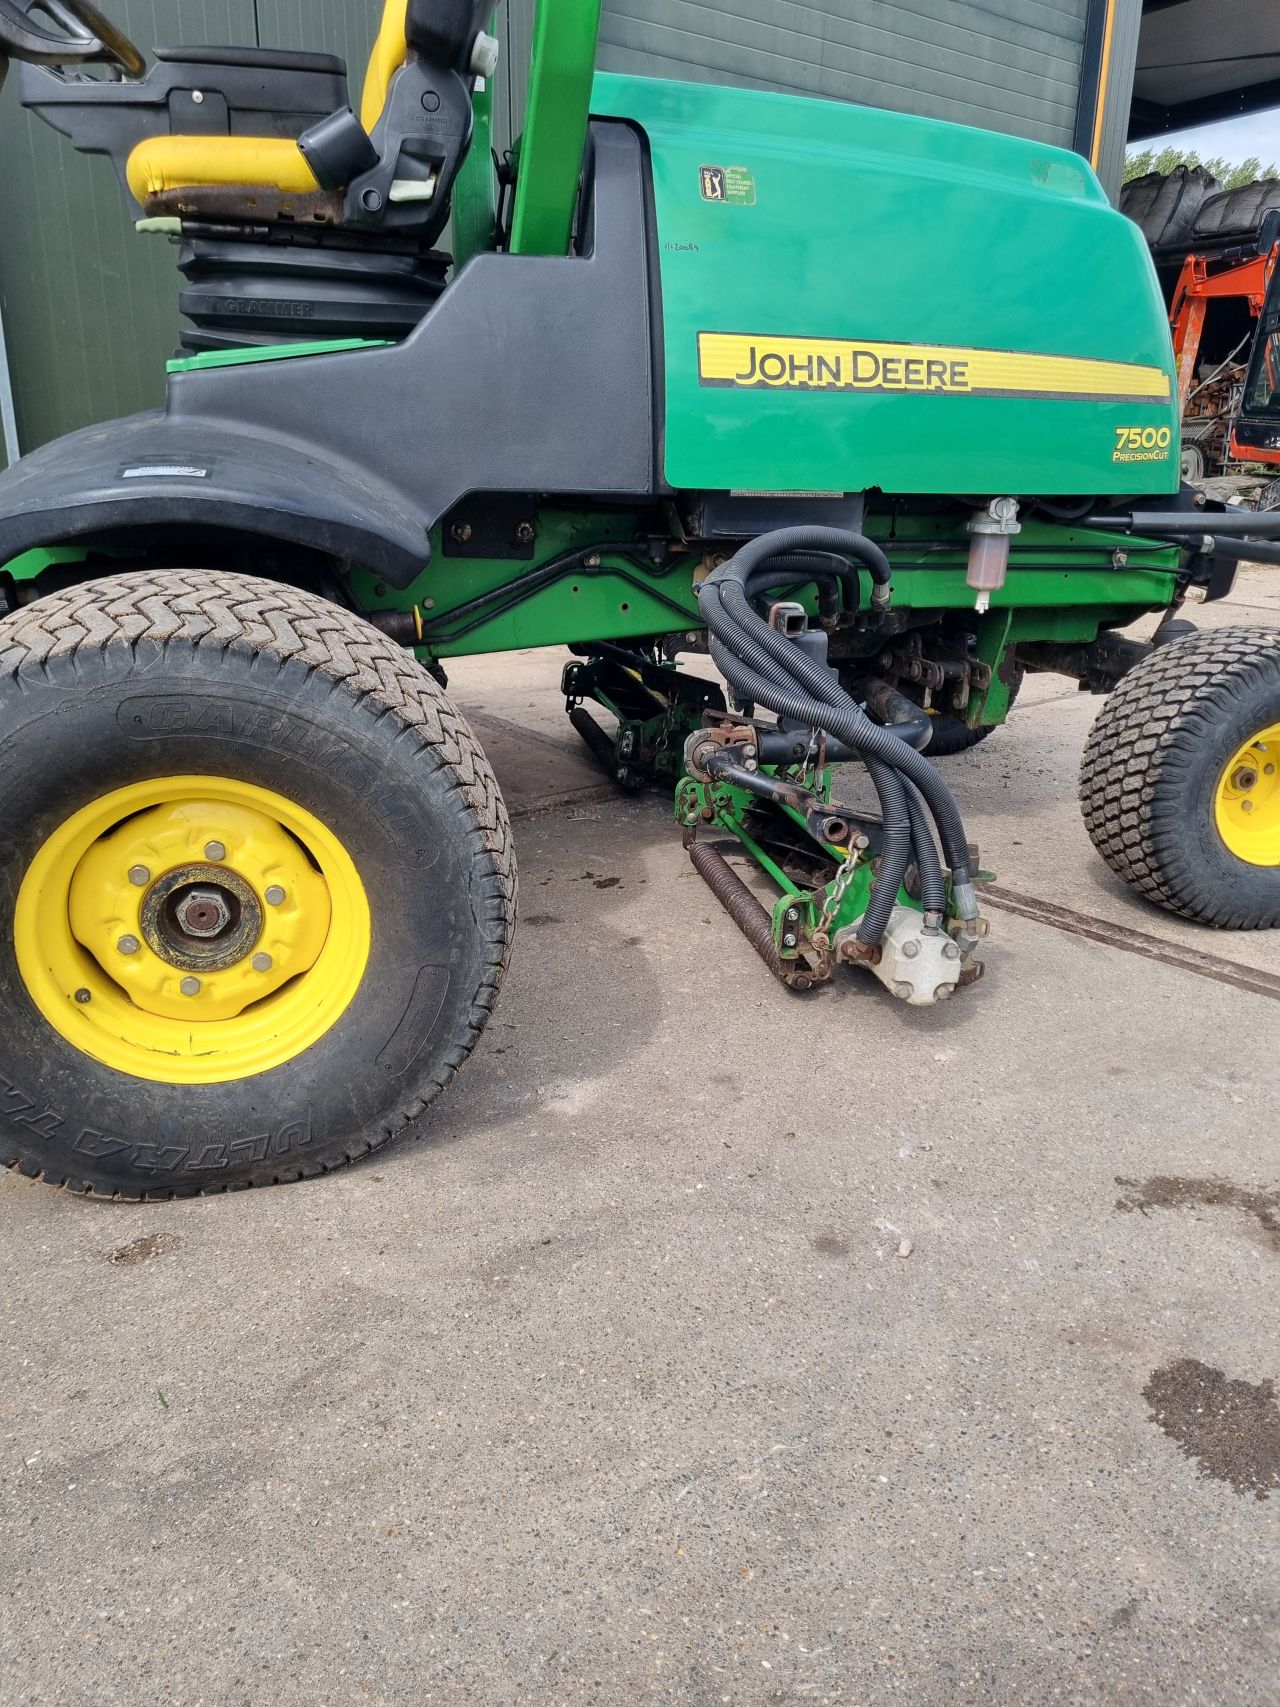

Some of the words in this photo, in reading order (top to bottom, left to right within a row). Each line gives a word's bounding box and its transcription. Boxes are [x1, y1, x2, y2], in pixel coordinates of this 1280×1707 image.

[224, 299, 314, 318] GRAMMER
[735, 346, 842, 383] JOHN
[851, 350, 970, 391] DEERE
[1115, 426, 1172, 449] 7500
[72, 1118, 313, 1171] ULTRA
